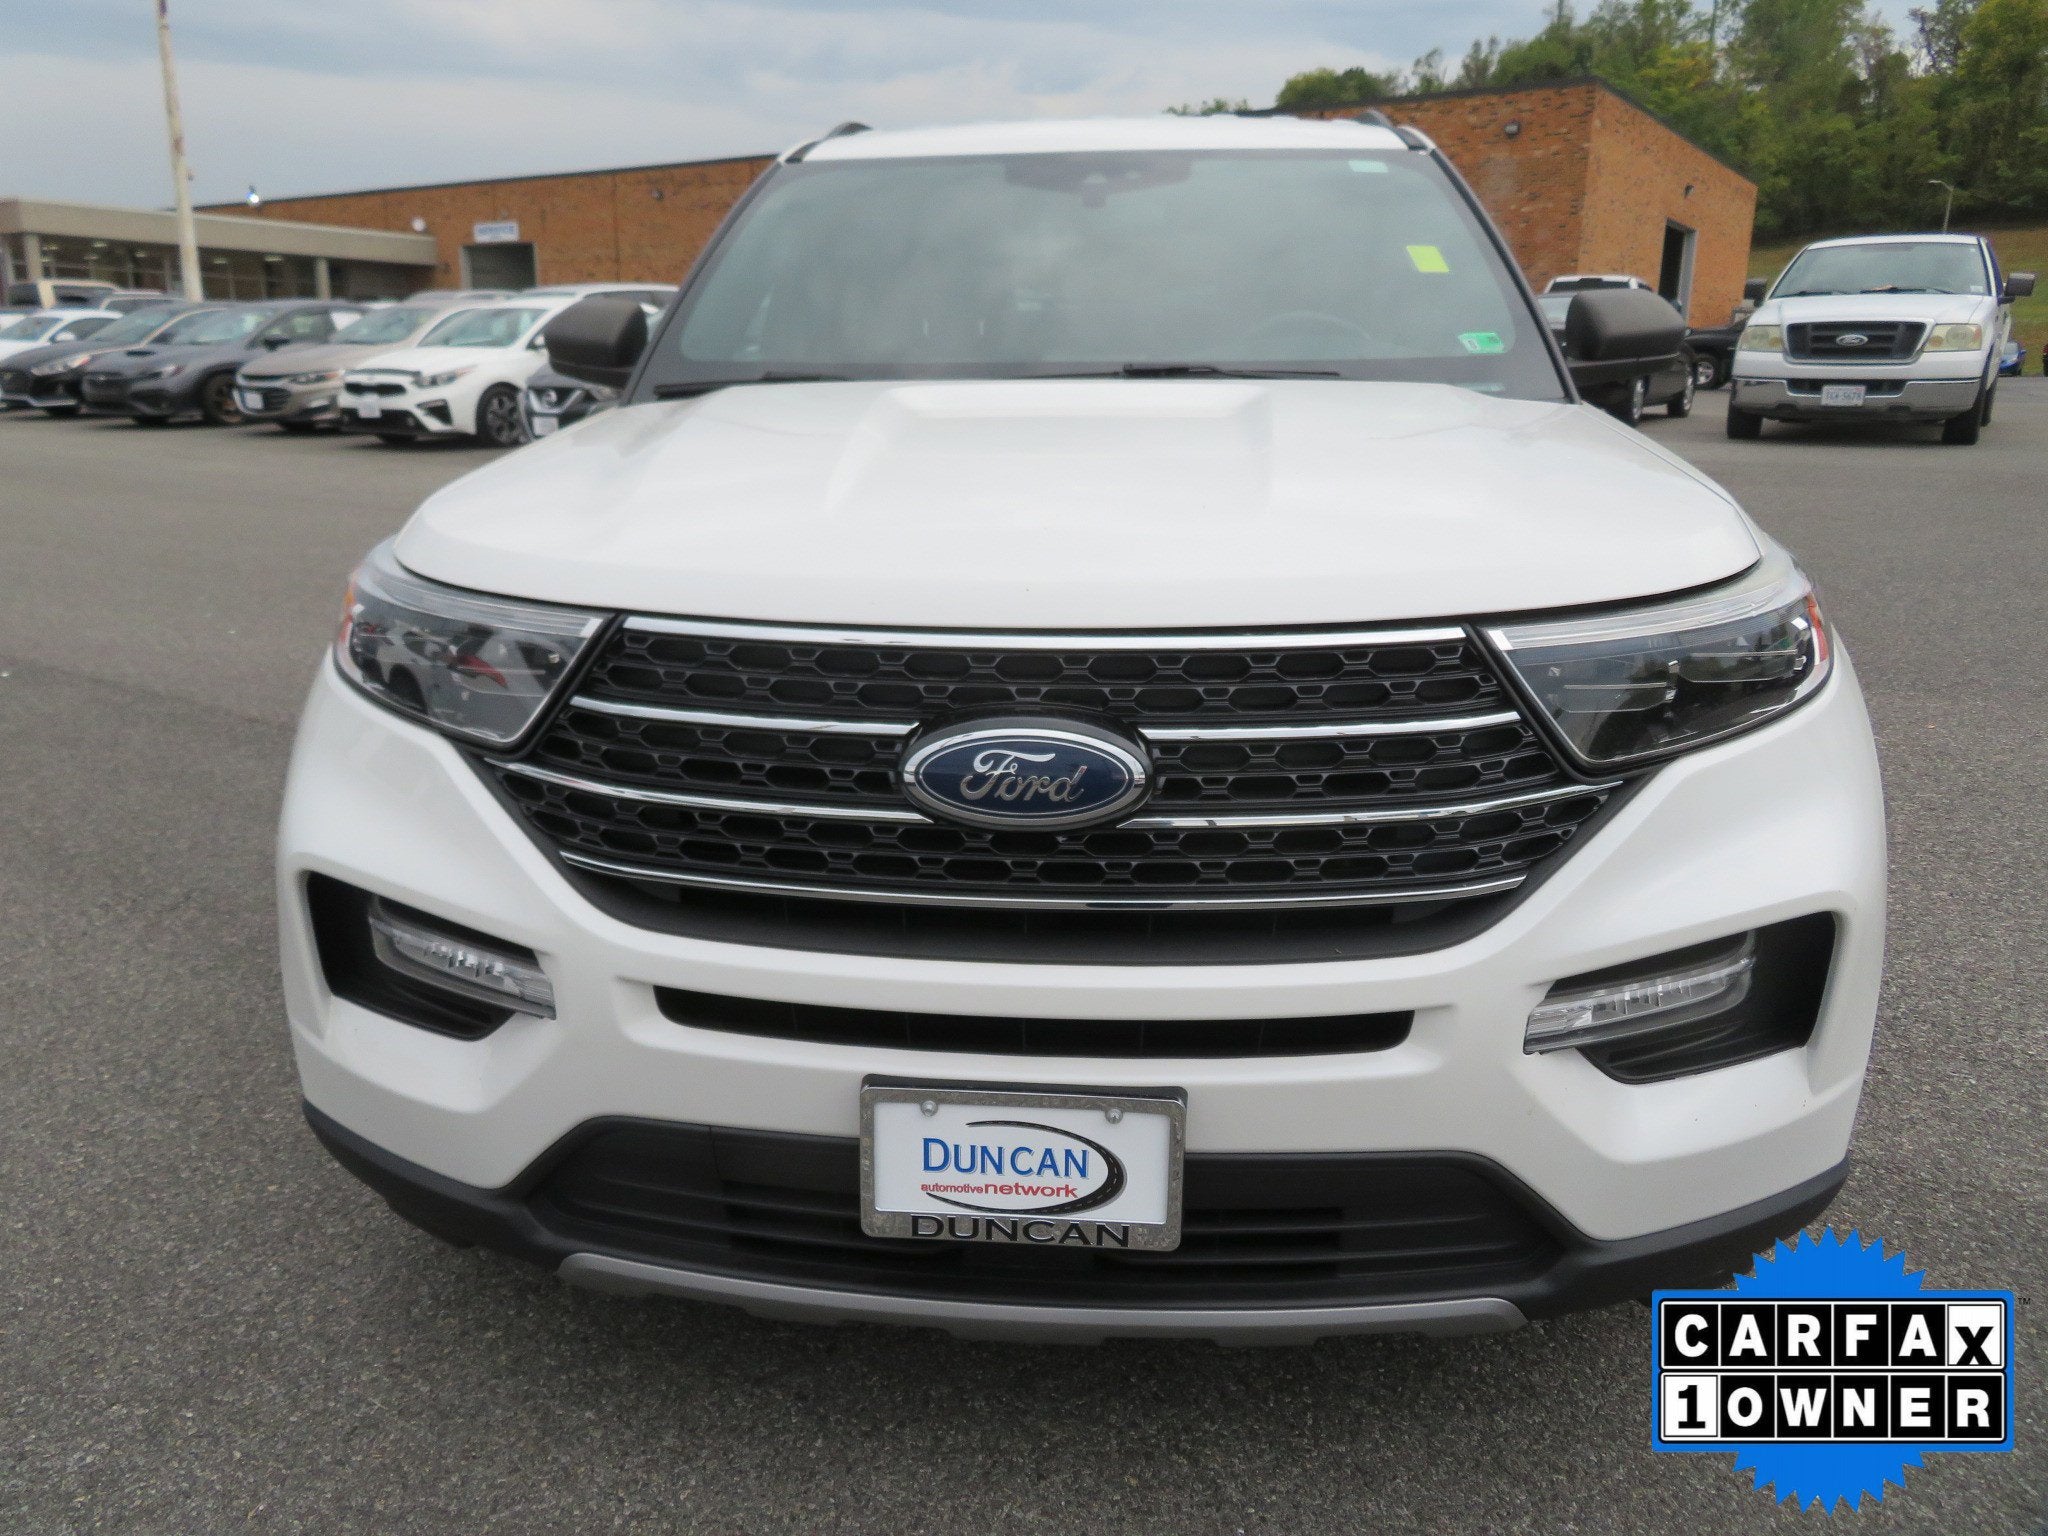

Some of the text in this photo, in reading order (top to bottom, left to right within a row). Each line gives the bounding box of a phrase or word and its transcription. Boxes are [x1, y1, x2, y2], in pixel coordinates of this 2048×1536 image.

[960, 749, 1088, 802] Ford
[921, 1137, 1090, 1180] DUNCAN
[910, 1214, 1131, 1248] DUNCAN
